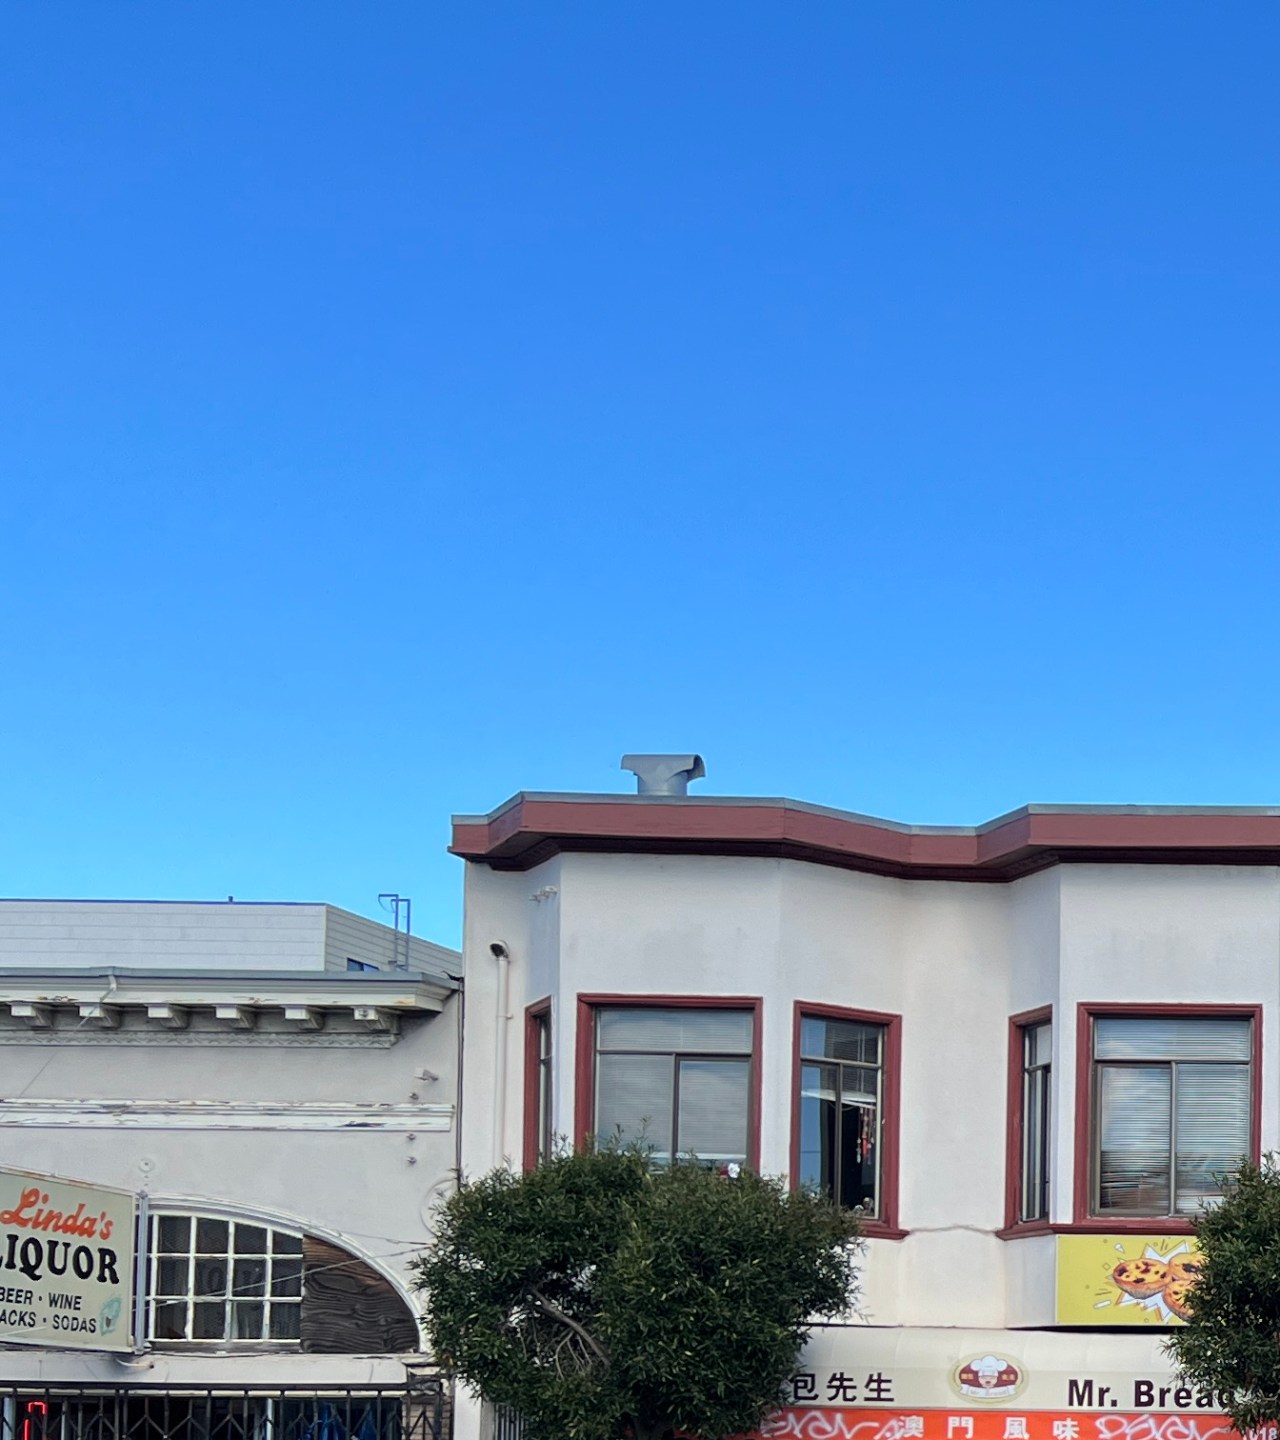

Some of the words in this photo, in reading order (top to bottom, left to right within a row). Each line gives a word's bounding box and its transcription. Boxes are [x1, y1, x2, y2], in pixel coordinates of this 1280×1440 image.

[1, 1187, 113, 1240] Linda's
[0, 1234, 120, 1284] IQUOR
[48, 1292, 82, 1311] WINE
[52, 1313, 96, 1333] SODAS
[1068, 1379, 1119, 1408] Mr.
